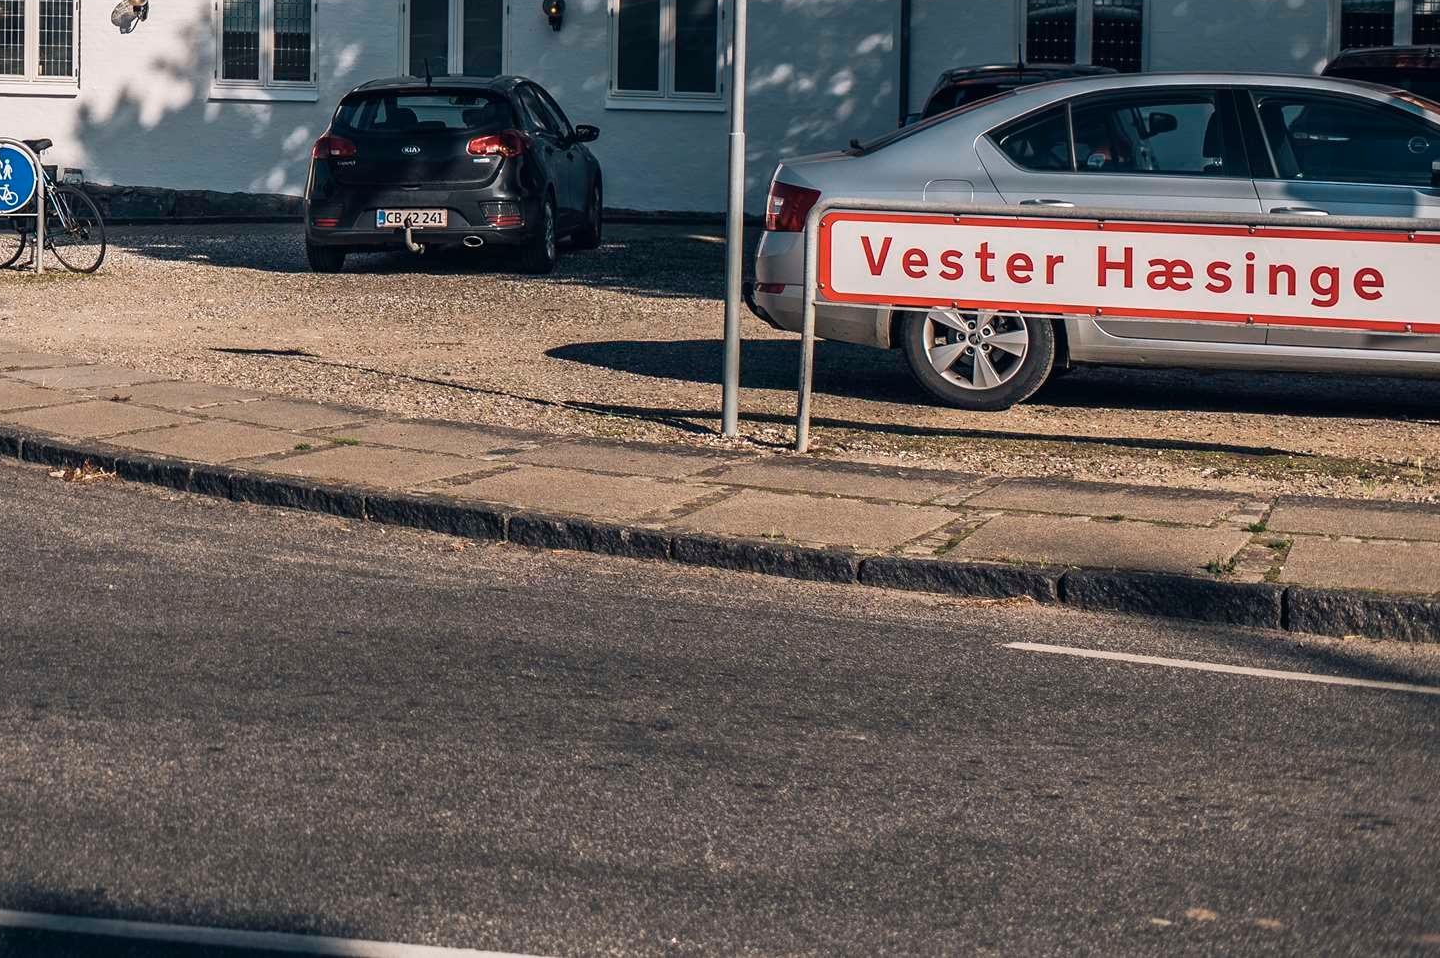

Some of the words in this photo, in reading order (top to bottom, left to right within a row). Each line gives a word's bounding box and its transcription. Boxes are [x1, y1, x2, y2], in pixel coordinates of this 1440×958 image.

[386, 212, 402, 223] CB
[422, 212, 443, 223] 241
[861, 235, 1064, 285] Vester
[1097, 245, 1385, 307] Hæsinge
